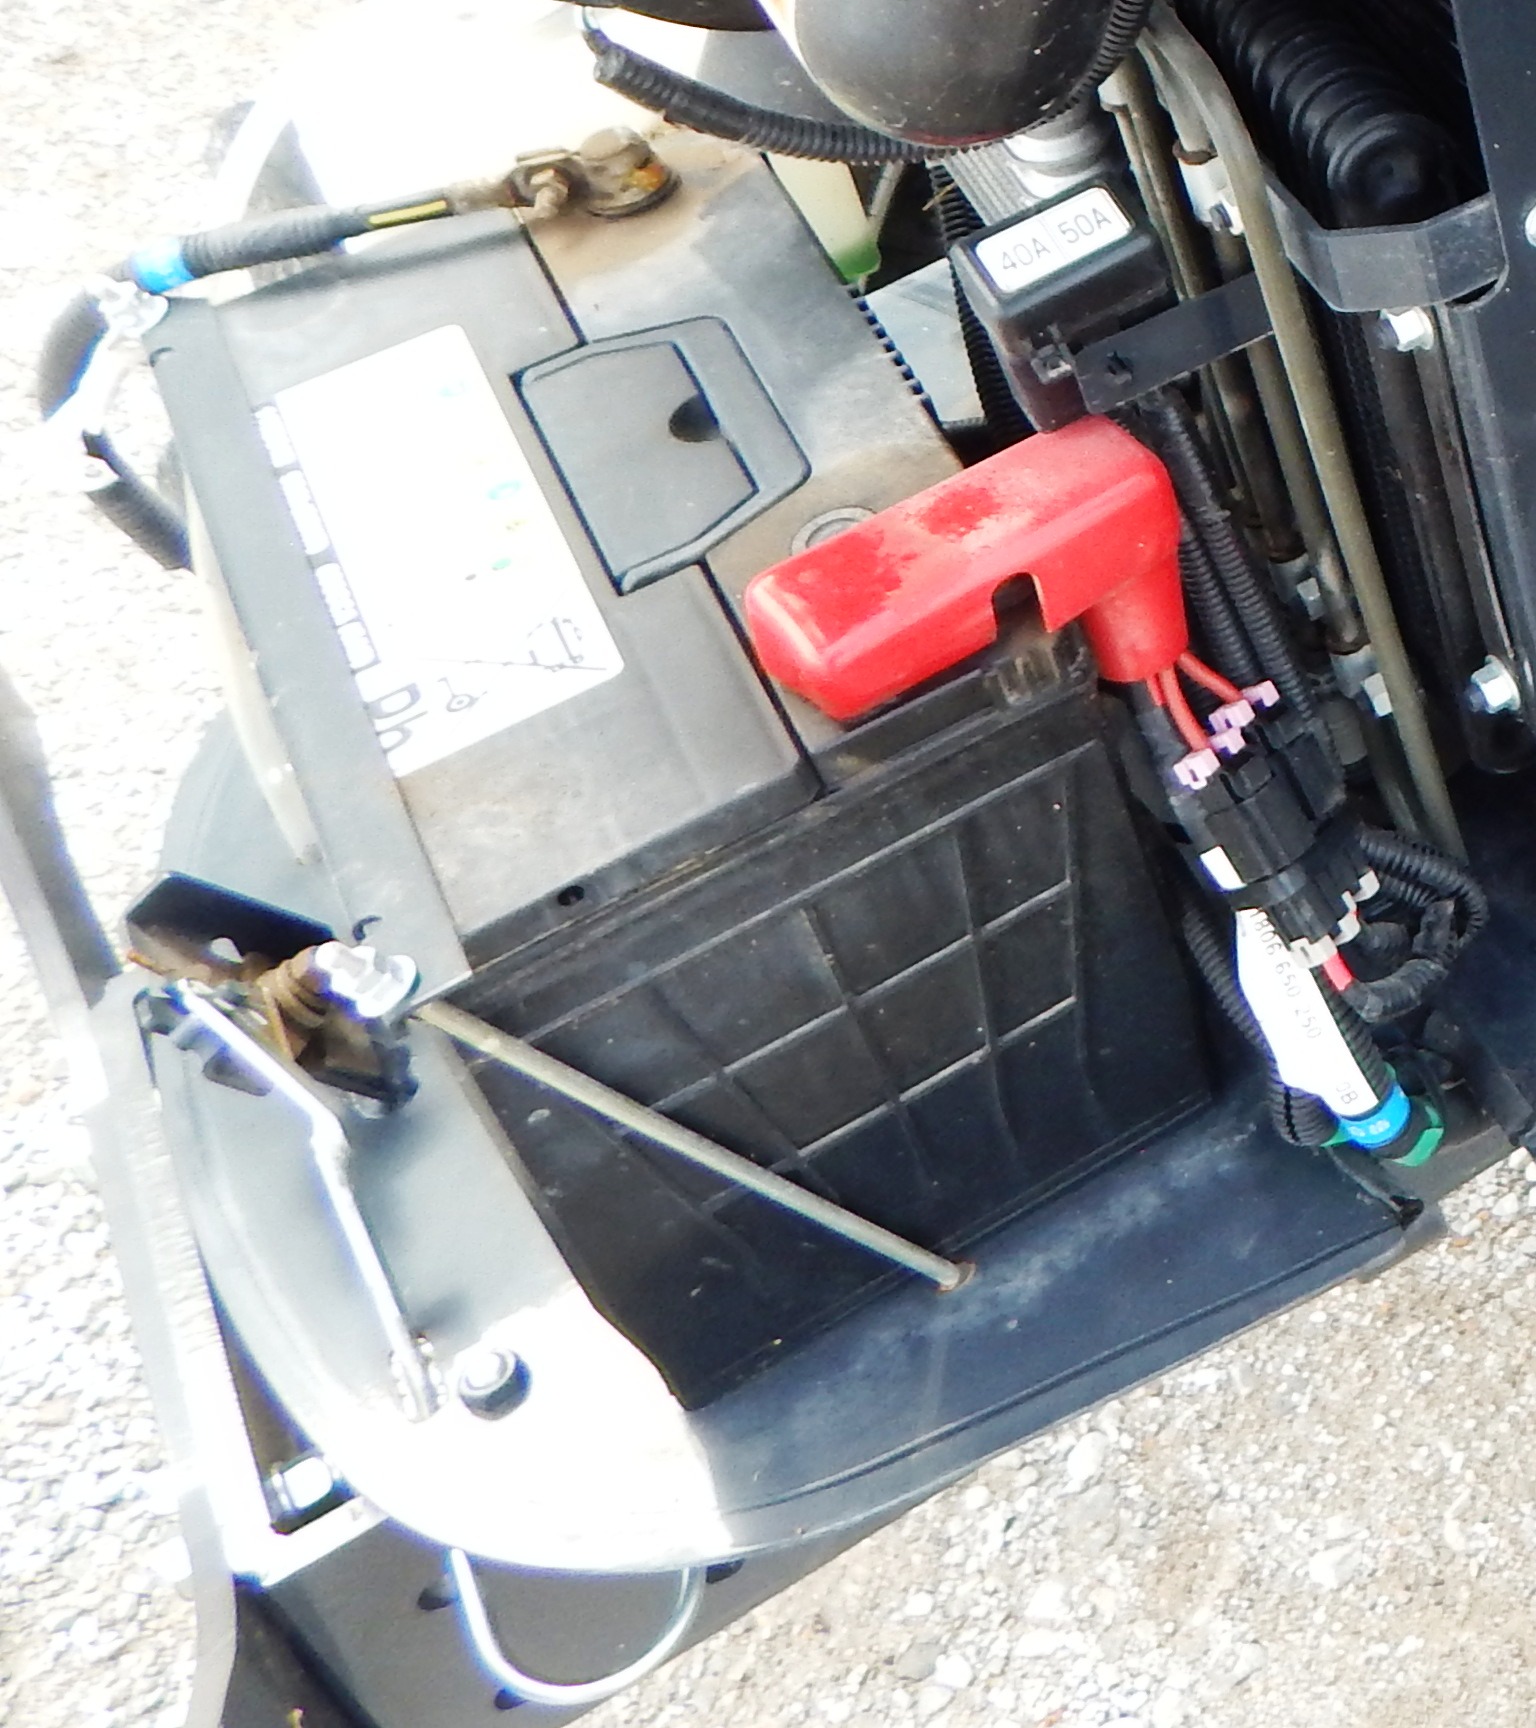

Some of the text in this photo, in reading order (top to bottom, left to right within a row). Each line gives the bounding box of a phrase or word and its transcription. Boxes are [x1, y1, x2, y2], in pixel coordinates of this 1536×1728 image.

[1001, 207, 1112, 270] 40A 50A
[1275, 961, 1302, 998] 650
